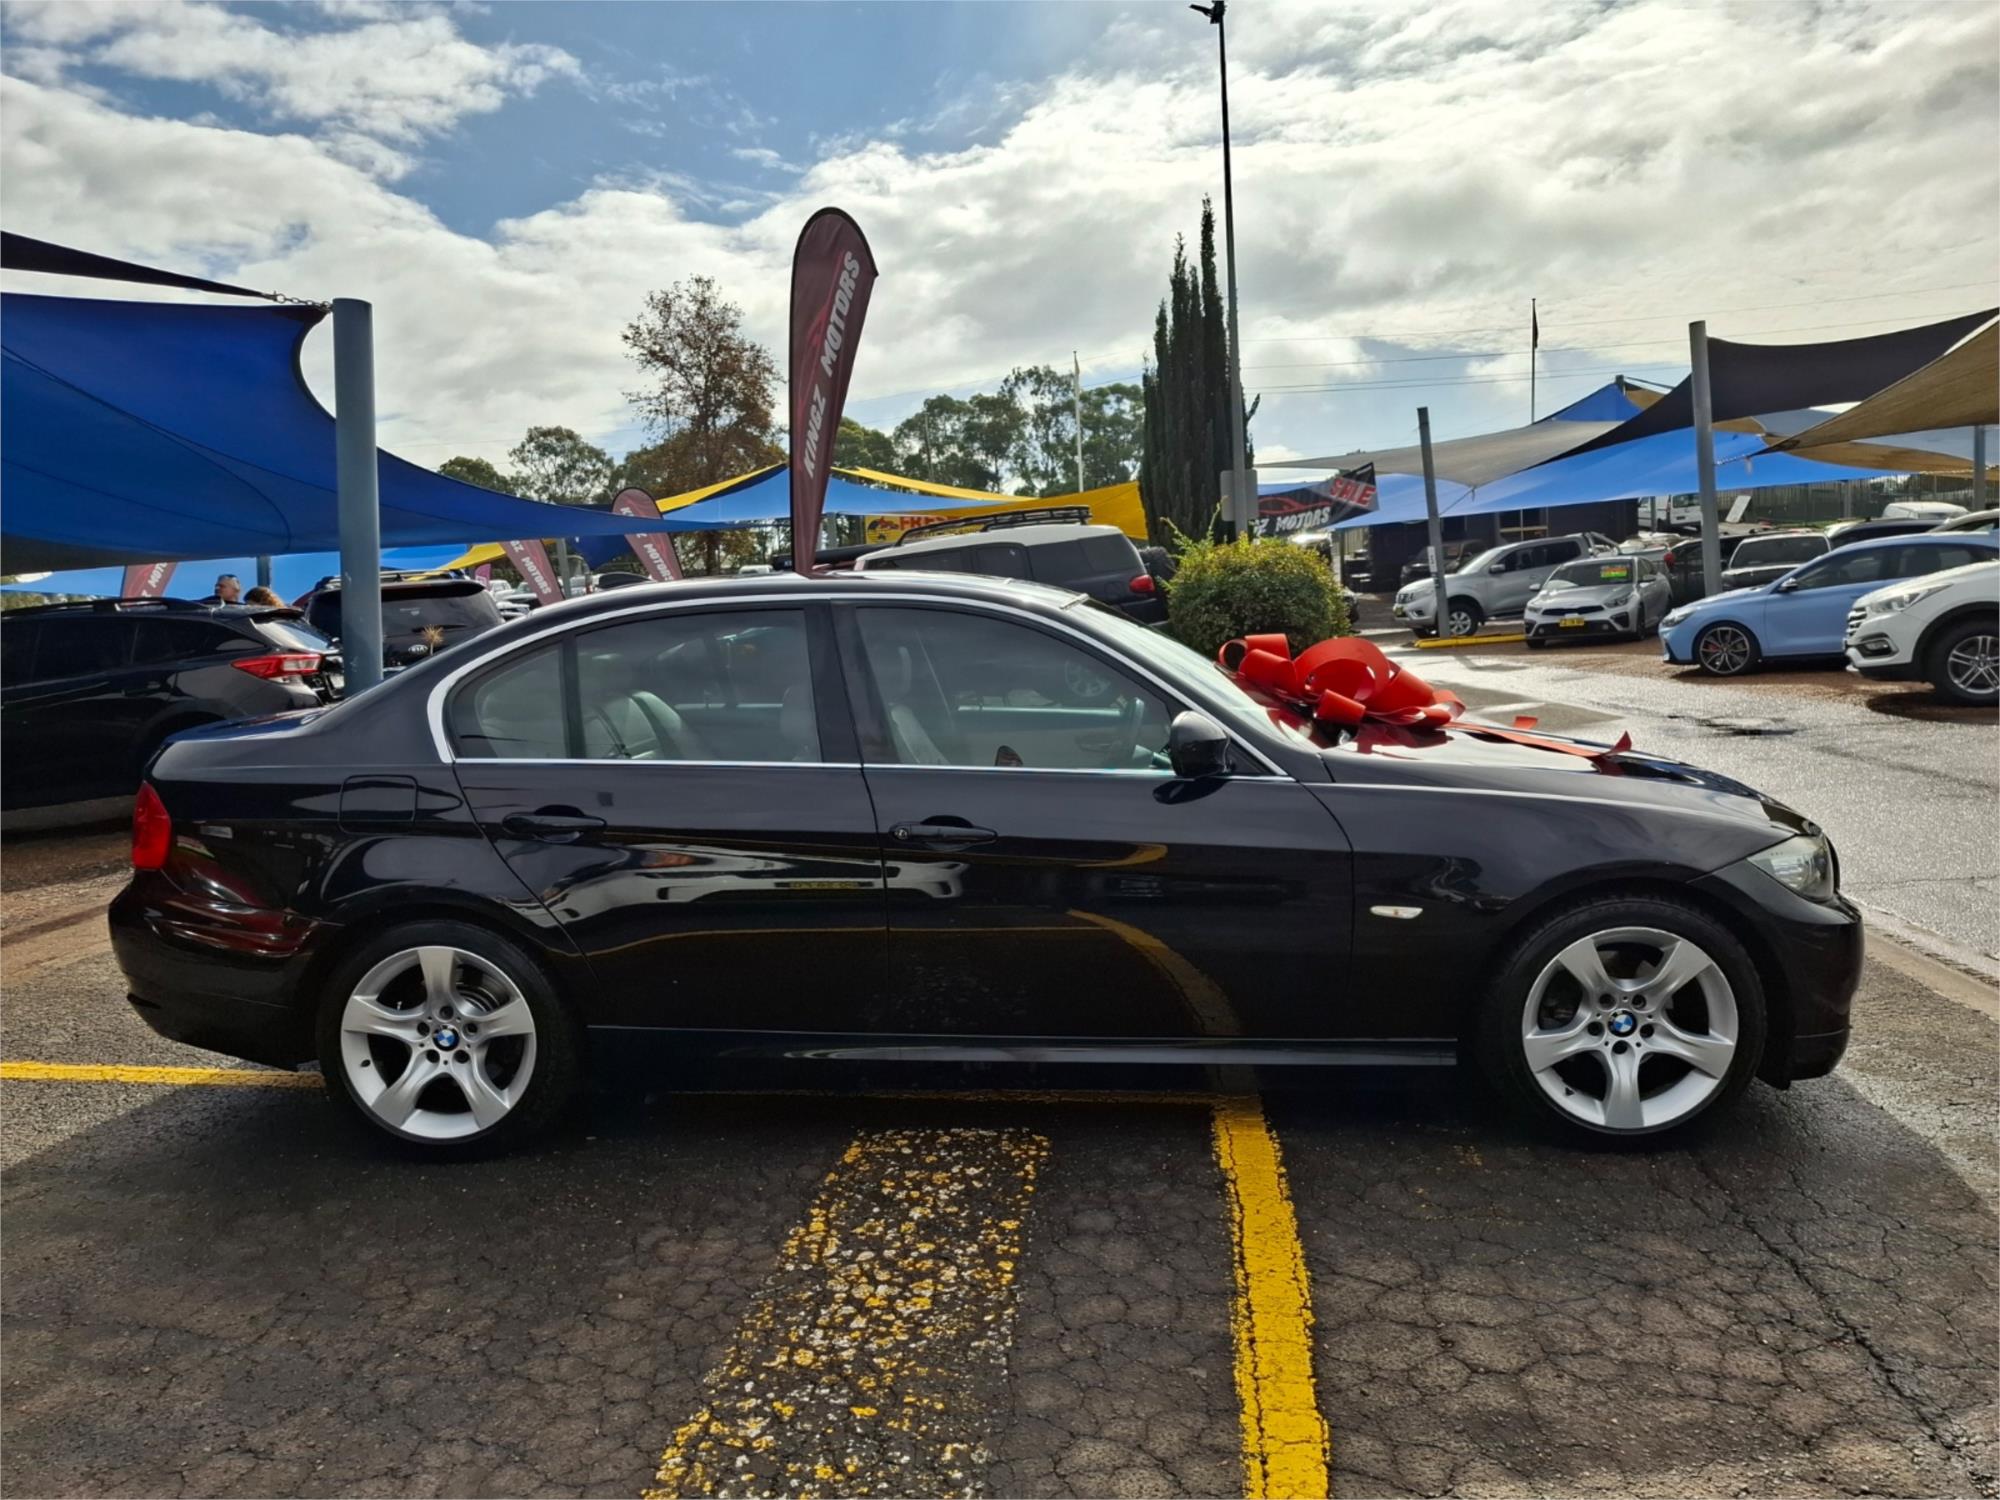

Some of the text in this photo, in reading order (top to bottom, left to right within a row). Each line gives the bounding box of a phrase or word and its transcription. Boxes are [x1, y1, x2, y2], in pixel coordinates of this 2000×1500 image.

[803, 251, 860, 478] KINGZ MOTORS
[1331, 479, 1376, 507] SALE
[1276, 508, 1331, 533] MOTORS
[521, 556, 552, 594] MOTORS
